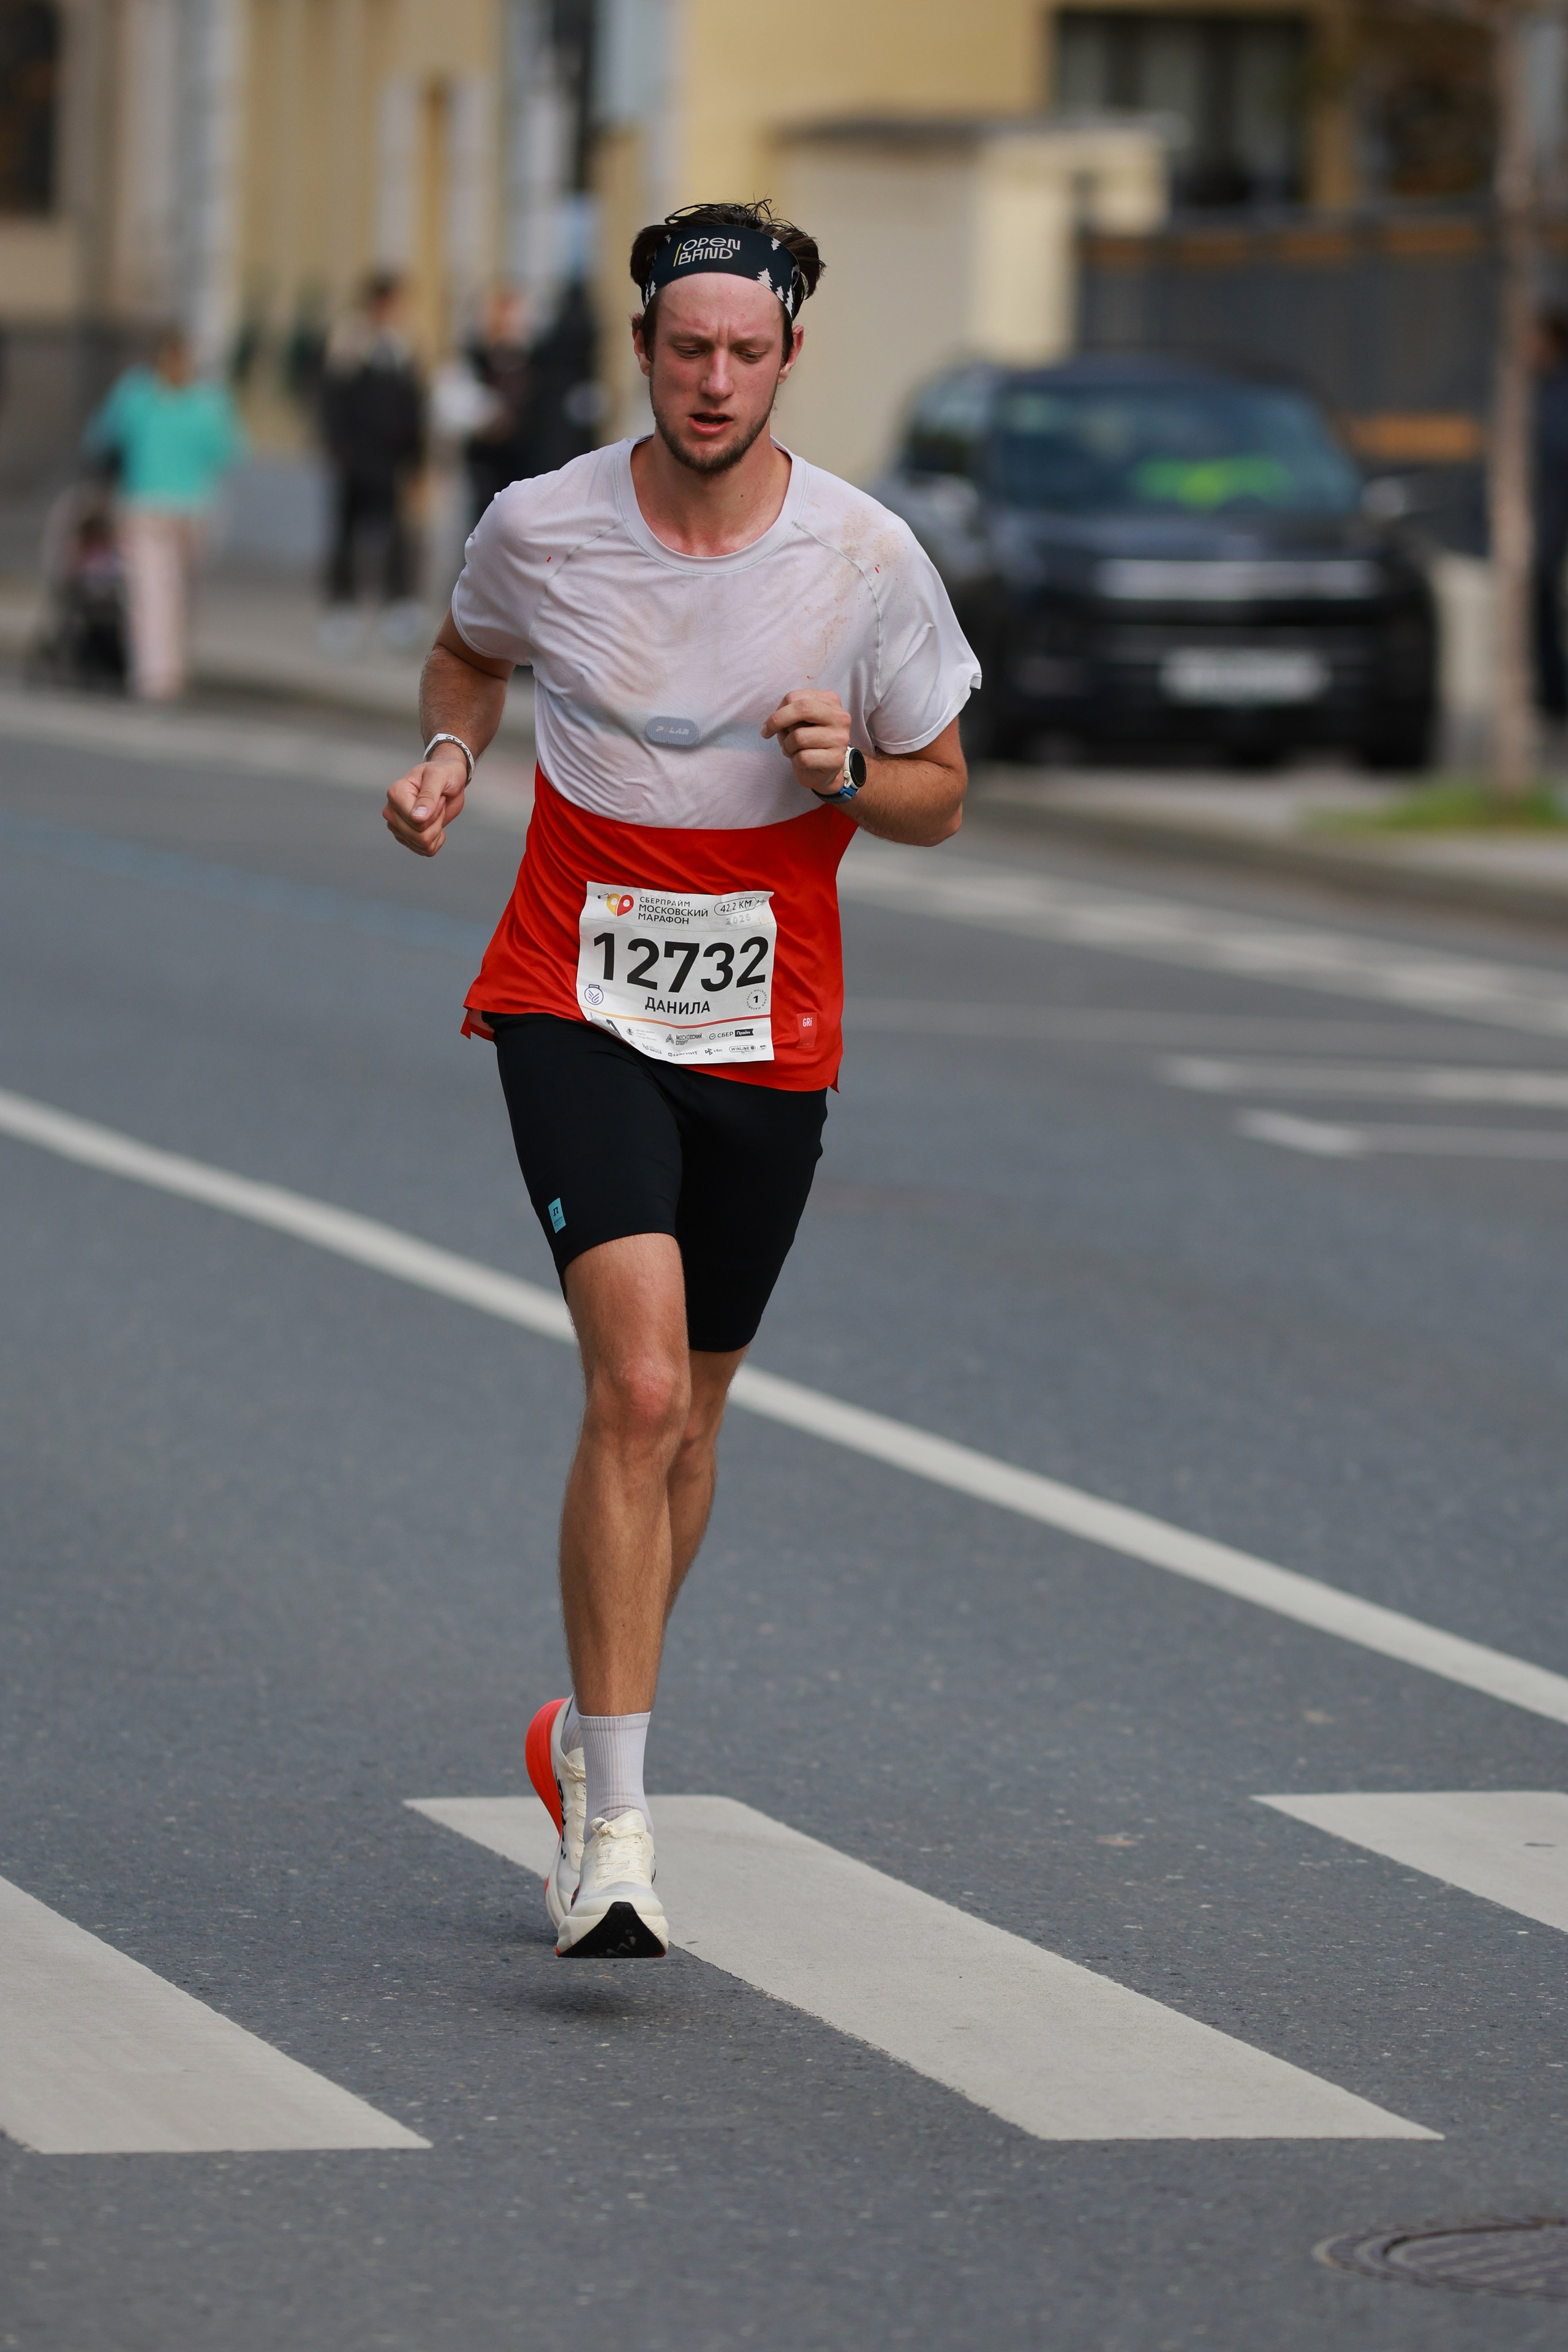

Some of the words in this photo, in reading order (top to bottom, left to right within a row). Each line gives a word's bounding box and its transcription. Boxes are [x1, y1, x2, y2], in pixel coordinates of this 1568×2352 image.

[678, 247, 734, 265] BAND
[639, 896, 690, 907] СБЕРПРАЙМ
[720, 902, 736, 913] 42,2
[739, 900, 752, 909] КМ
[639, 904, 708, 917] МОСКОВСКИЙ
[638, 913, 689, 925] МАРАФОН
[725, 913, 751, 925] 2026
[594, 932, 769, 993] 12732
[645, 997, 710, 1015] ДАНИЛА
